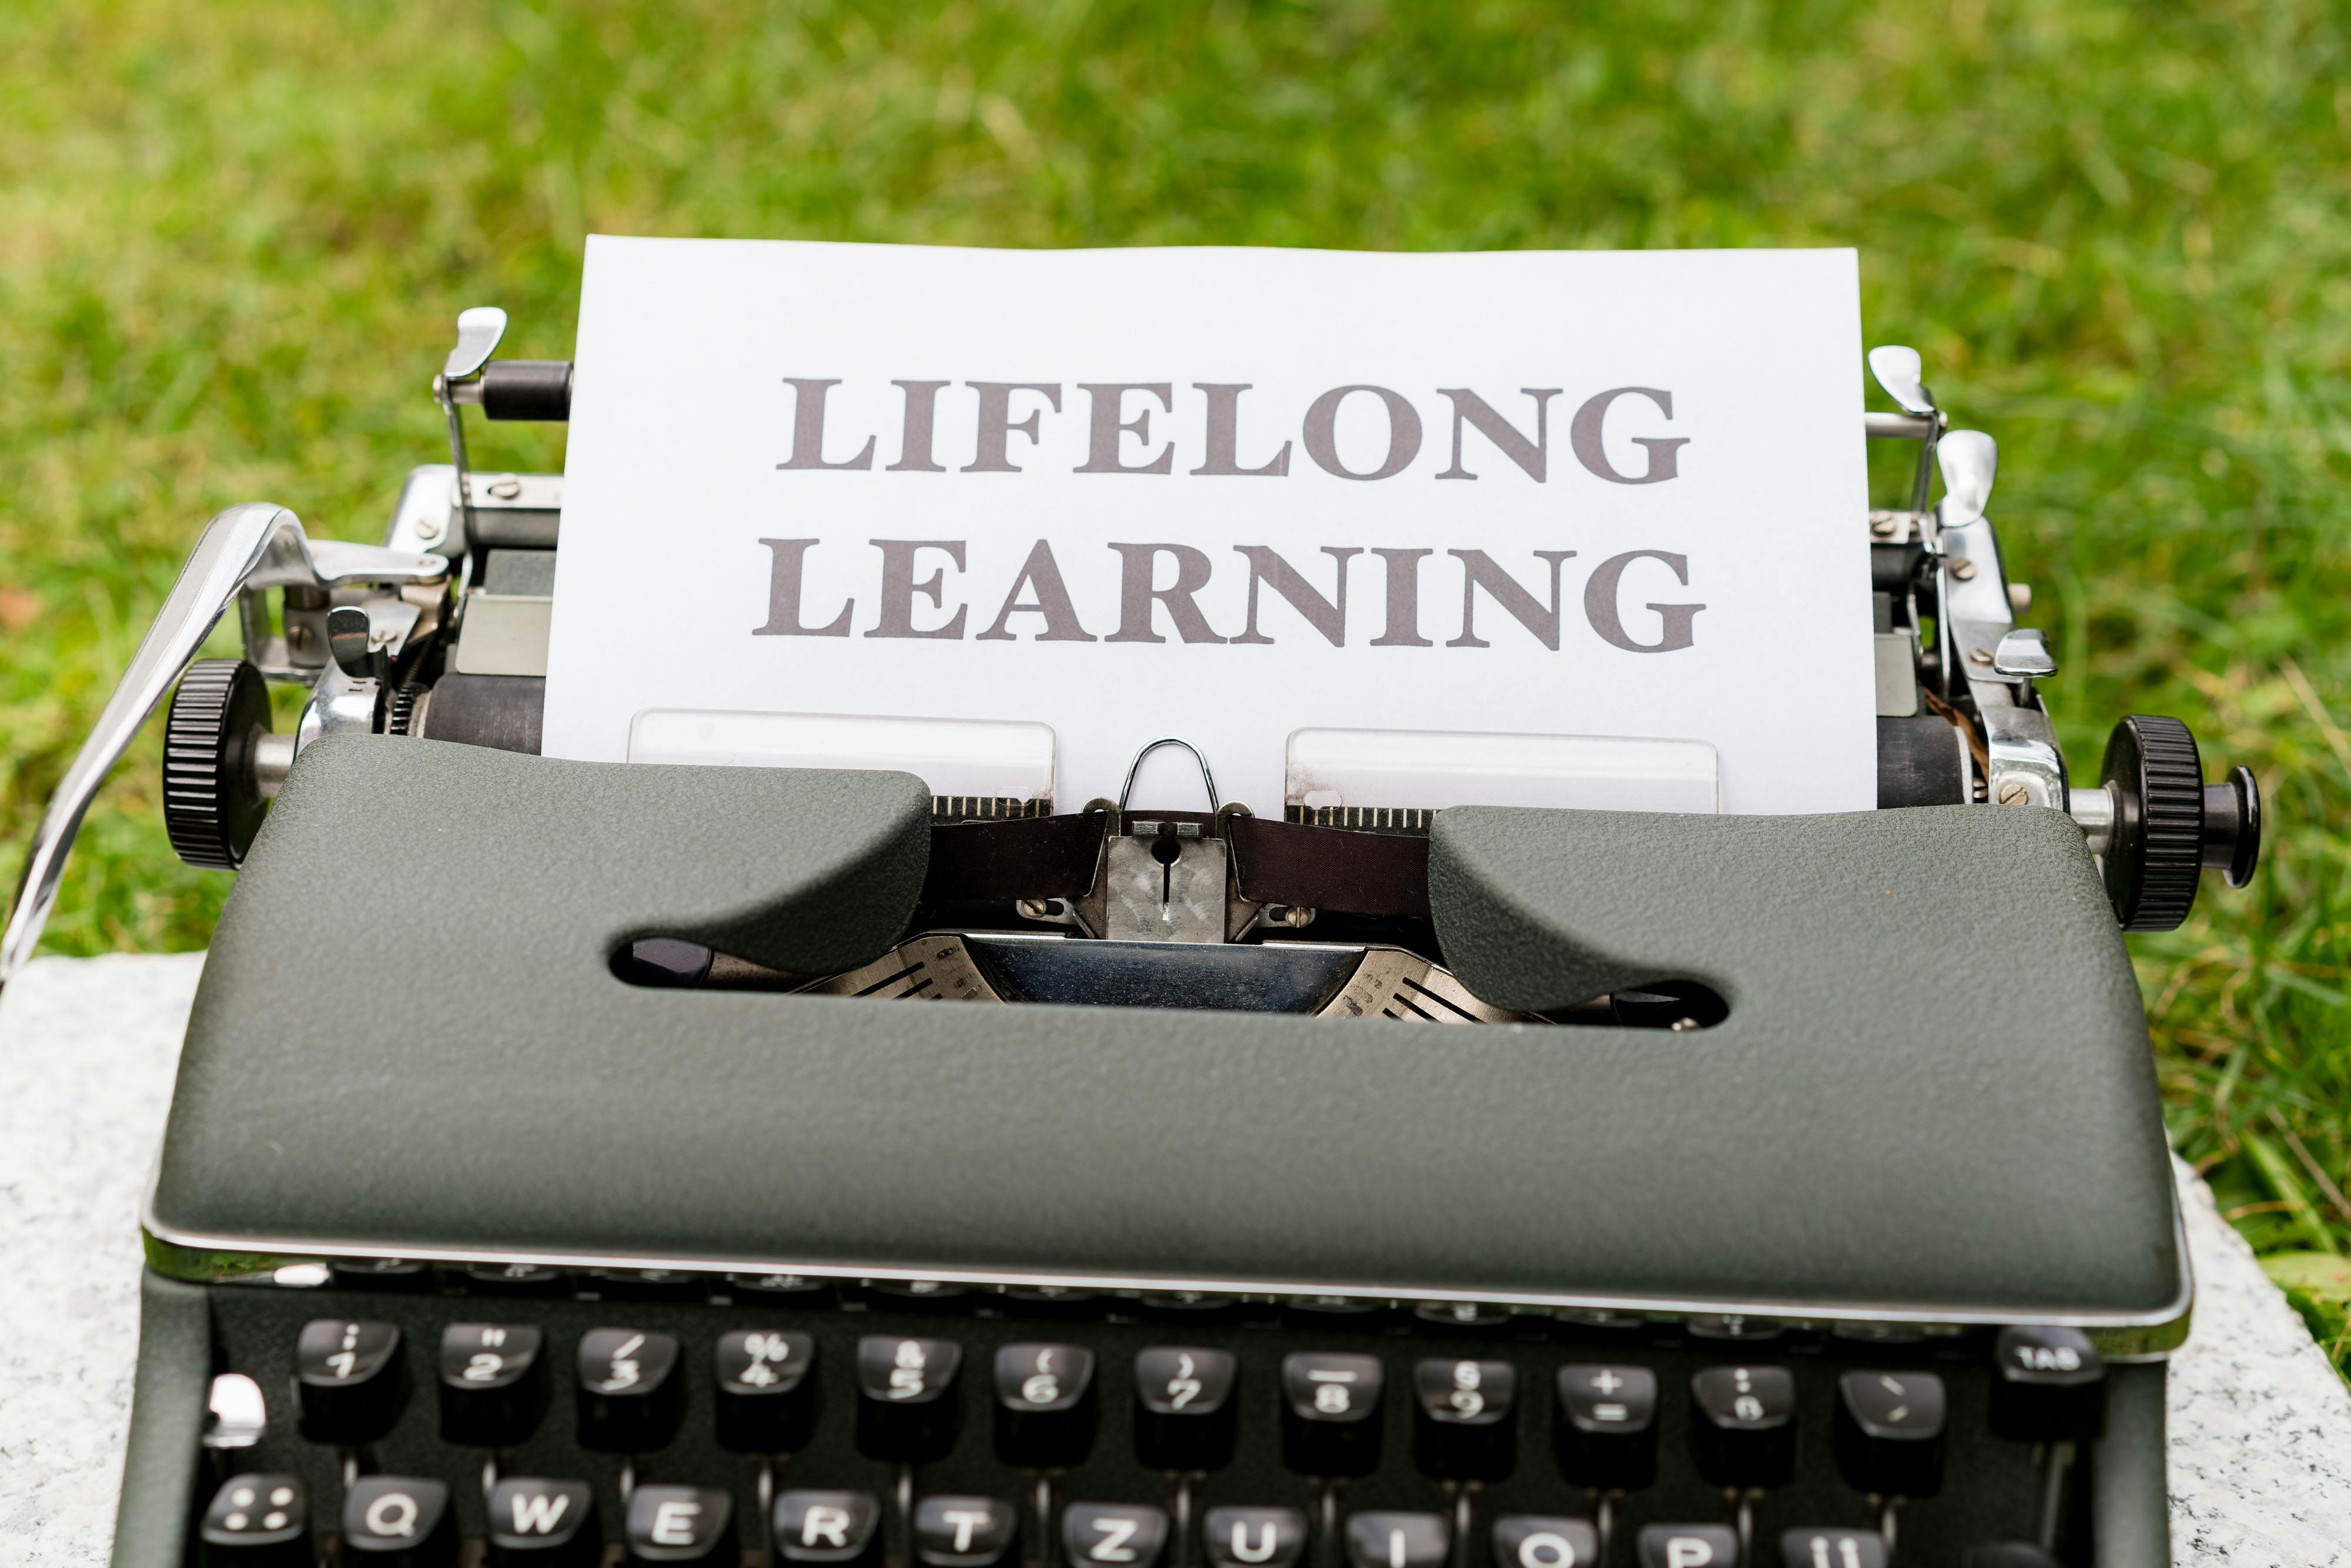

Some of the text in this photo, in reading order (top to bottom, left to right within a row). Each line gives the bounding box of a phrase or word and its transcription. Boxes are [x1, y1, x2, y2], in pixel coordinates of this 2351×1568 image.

[775, 377, 1691, 486] LIFELONG
[751, 537, 1707, 654] LEARNING
[743, 1333, 789, 1362] %
[2014, 1345, 2082, 1371] TAB
[463, 1353, 504, 1382] 2
[601, 1359, 641, 1391] 3
[739, 1362, 780, 1388] 4
[887, 1368, 925, 1399] 5
[1590, 1368, 1624, 1395] +
[1022, 1373, 1059, 1405] 6
[1168, 1379, 1202, 1411] 7
[1313, 1383, 1351, 1414] 8
[1450, 1390, 1485, 1419] 9
[364, 1492, 419, 1537] Q
[510, 1492, 570, 1534] W
[651, 1499, 702, 1546] E
[801, 1503, 851, 1546] R
[941, 1509, 991, 1552] T
[1091, 1517, 1139, 1562] Z
[1230, 1520, 1278, 1563] U
[1519, 1531, 1577, 1568] O
[1666, 1536, 1715, 1568] P
